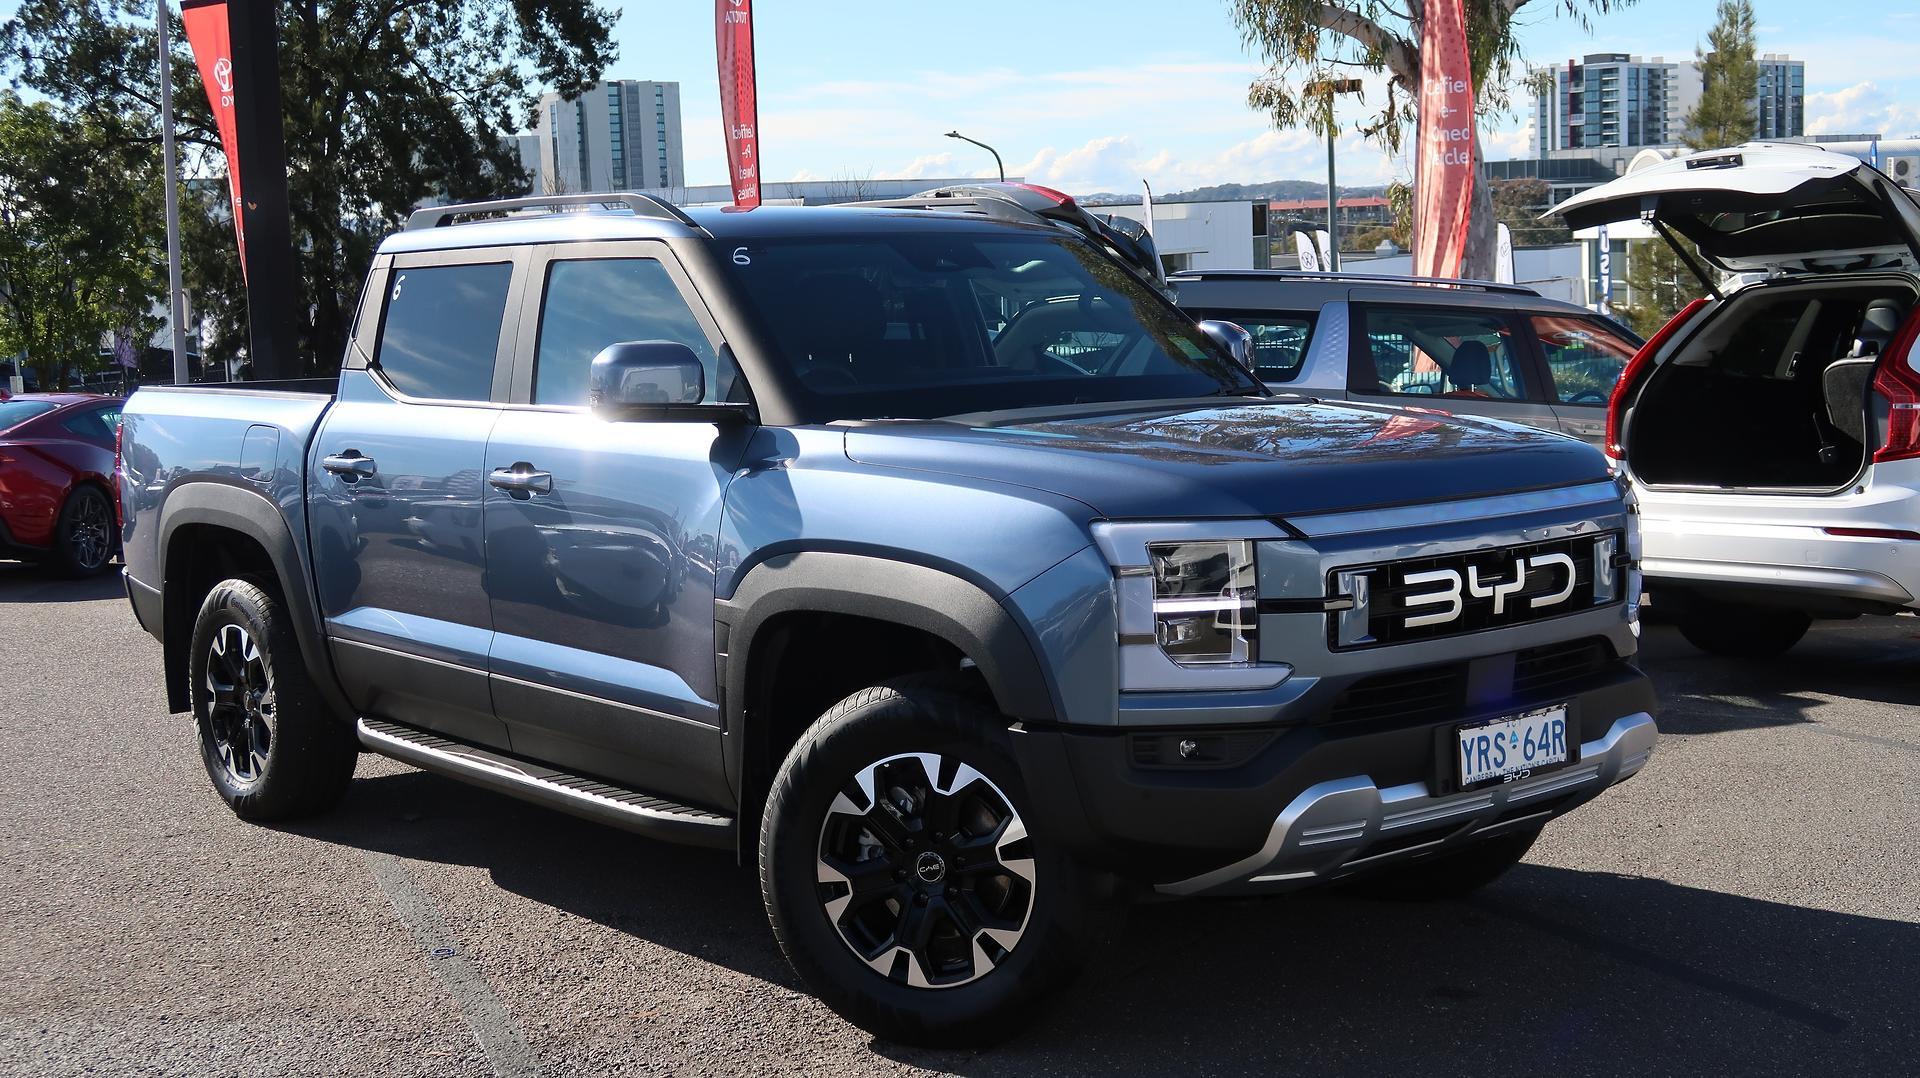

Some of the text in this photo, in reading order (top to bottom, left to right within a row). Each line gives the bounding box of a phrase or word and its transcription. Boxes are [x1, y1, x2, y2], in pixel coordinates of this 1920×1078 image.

[732, 246, 751, 266] 6
[392, 275, 406, 301] 6
[1404, 552, 1576, 628] BYD
[1461, 719, 1565, 775] YRS 64R
[1503, 769, 1531, 784] BYD
